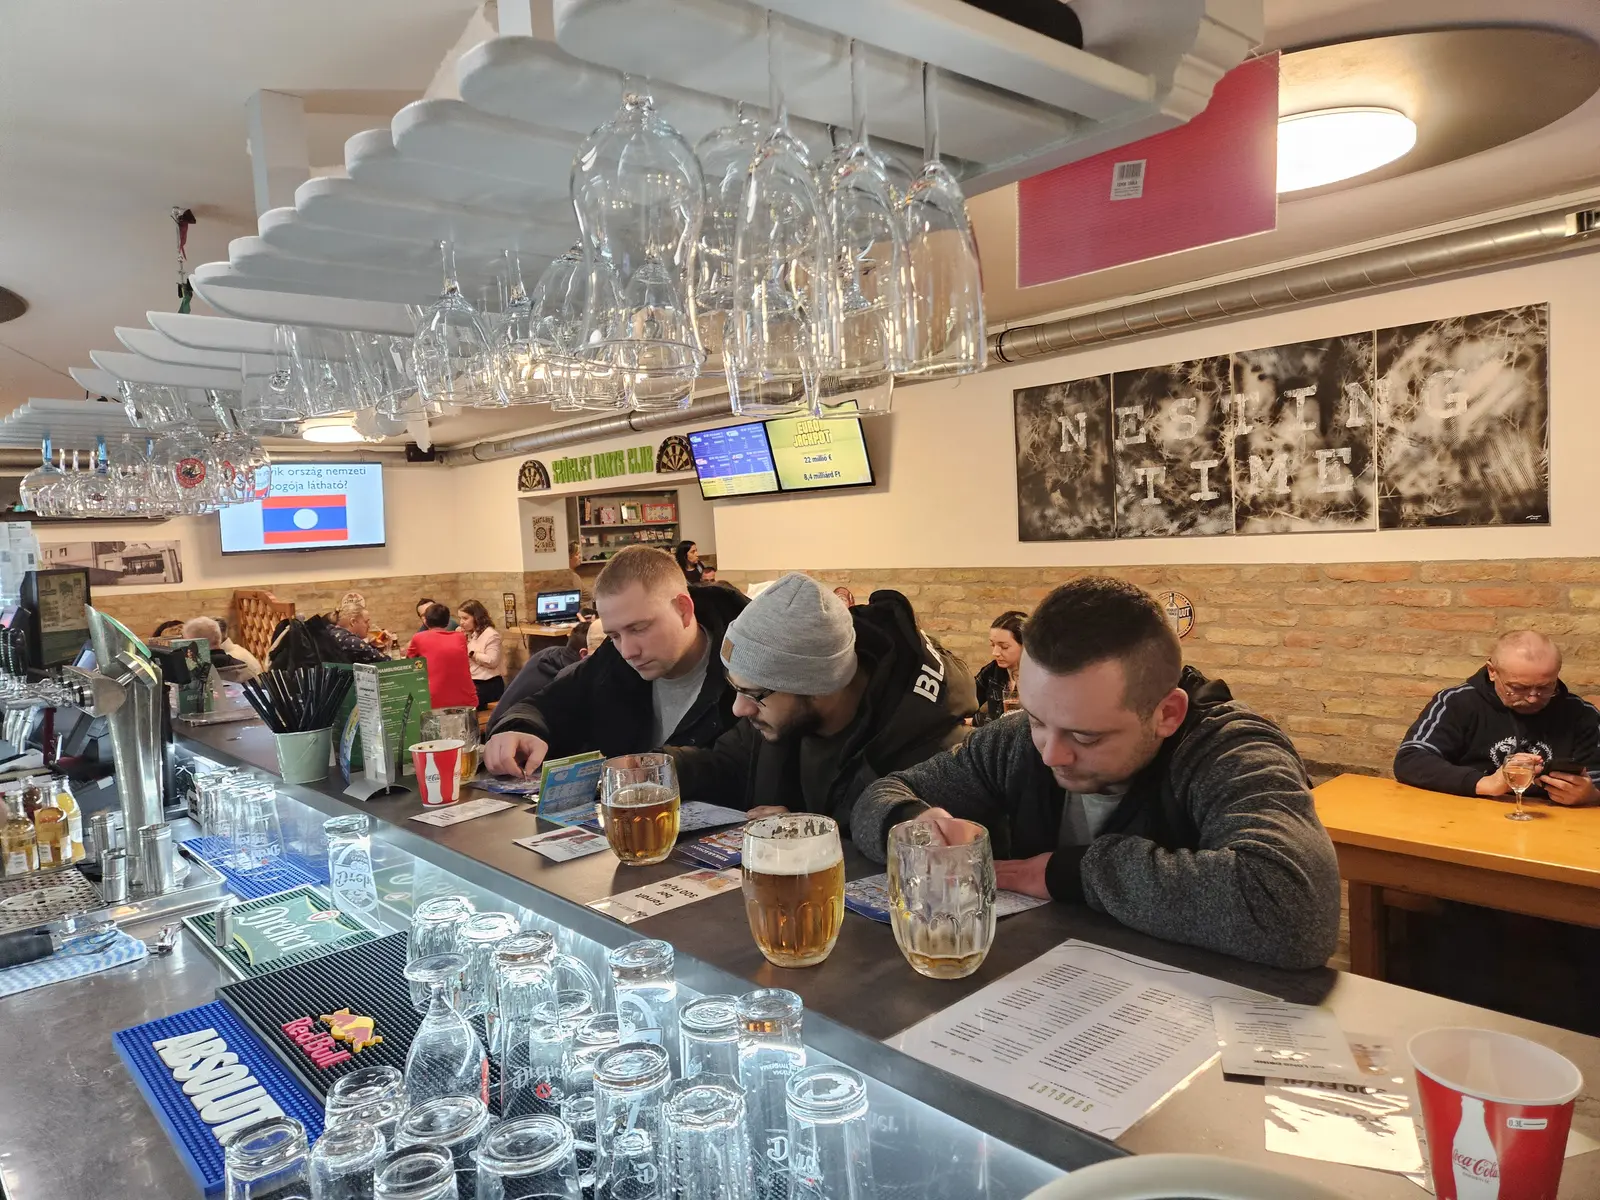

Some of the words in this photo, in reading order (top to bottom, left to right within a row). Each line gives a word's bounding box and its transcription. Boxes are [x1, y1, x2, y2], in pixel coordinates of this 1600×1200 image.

[1057, 368, 1470, 453] NESTING
[796, 419, 821, 435] EURO
[793, 429, 831, 448] JACKPOT
[593, 450, 626, 479] DARTS
[627, 445, 654, 474] CLUB
[803, 456, 812, 464] 22
[287, 466, 322, 479] ország
[325, 466, 367, 476] nemzeti
[803, 473, 813, 481] 8,4
[1134, 446, 1354, 506] TIME
[307, 480, 348, 490] látható?
[233, 906, 320, 952] Dreher
[281, 1016, 328, 1046] Red
[303, 1036, 352, 1071] Bull
[1508, 1119, 1522, 1128] 0.3L
